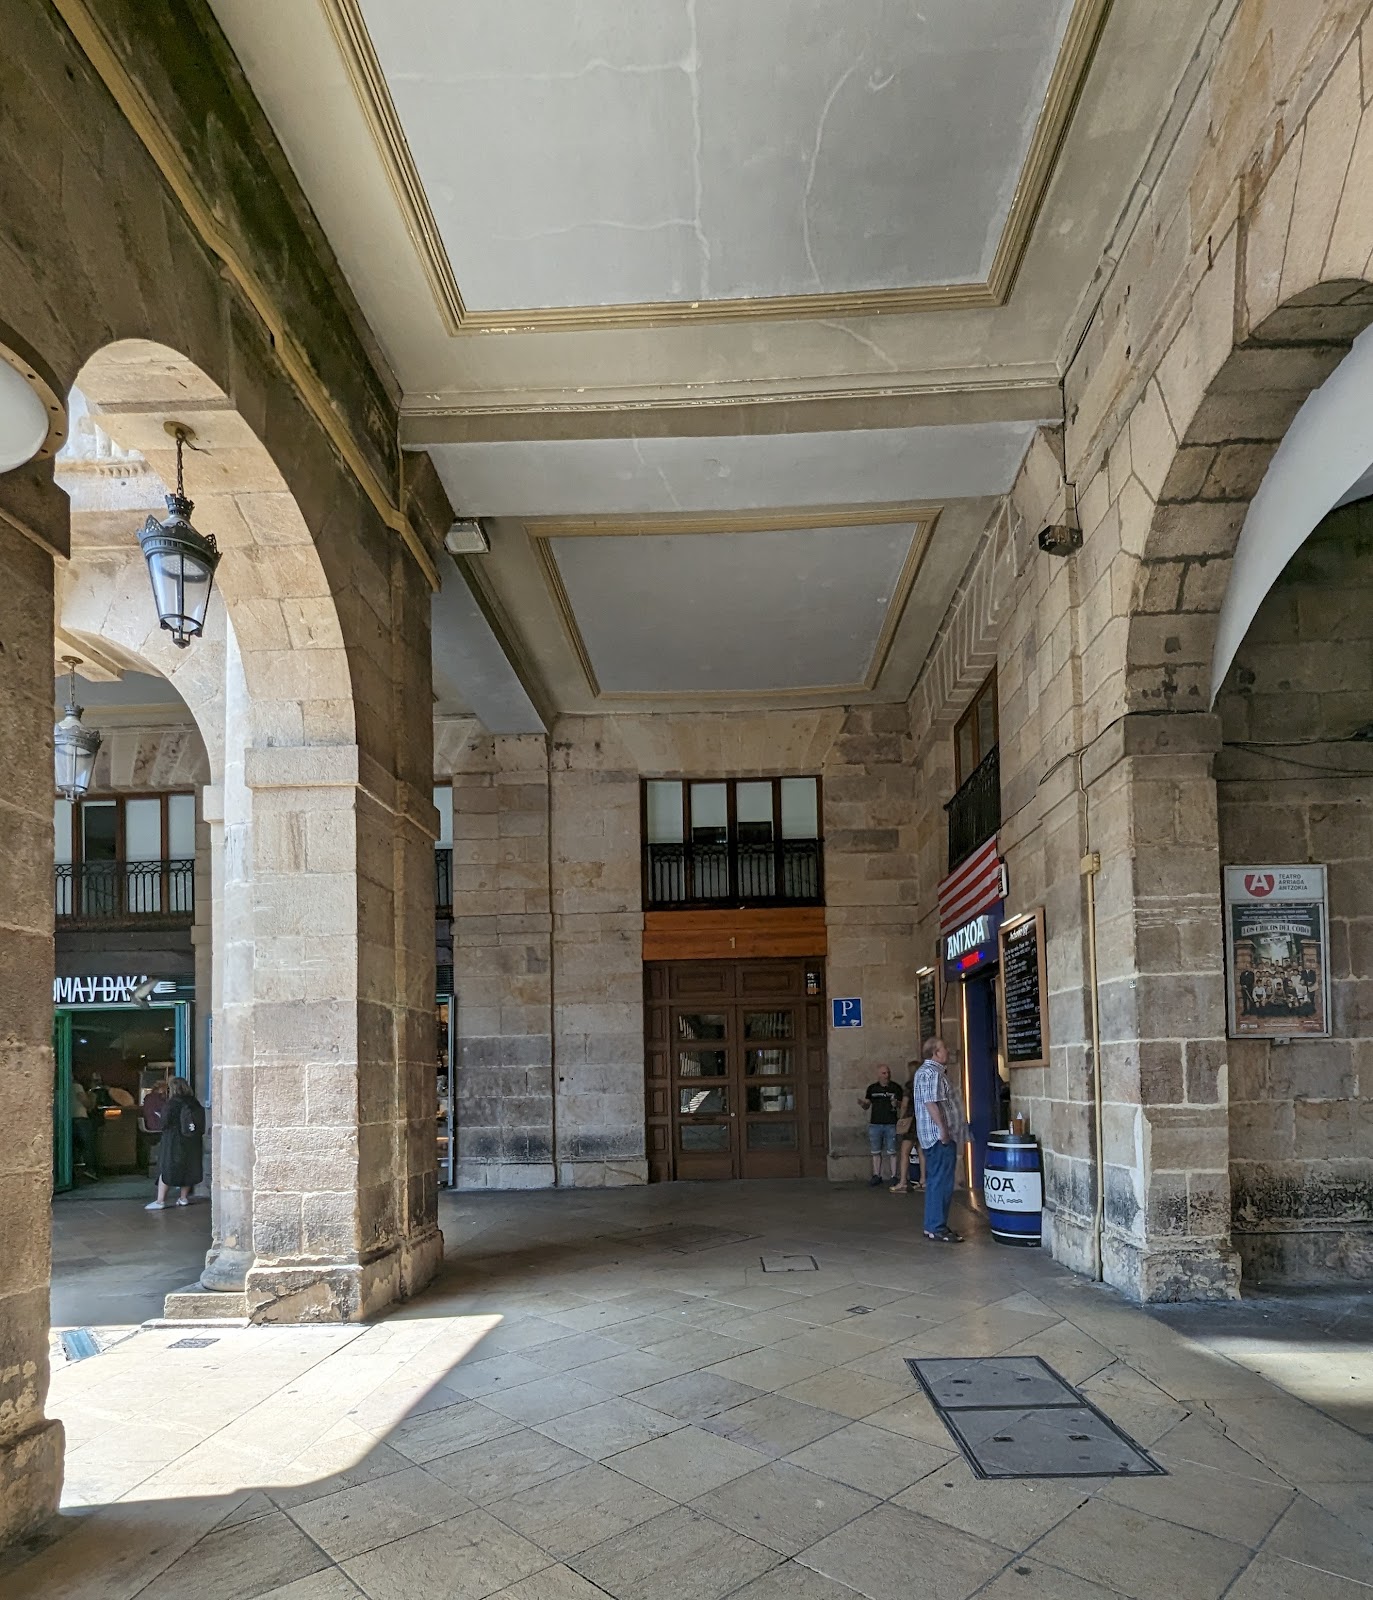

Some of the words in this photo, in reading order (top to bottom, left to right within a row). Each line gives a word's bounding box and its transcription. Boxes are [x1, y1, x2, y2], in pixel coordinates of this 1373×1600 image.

[729, 936, 736, 949] 1
[947, 914, 986, 960] ANTXOA
[53, 977, 84, 1003] MA
[87, 976, 98, 1003] Y
[841, 1000, 854, 1017] P
[983, 1174, 1016, 1192] XOA
